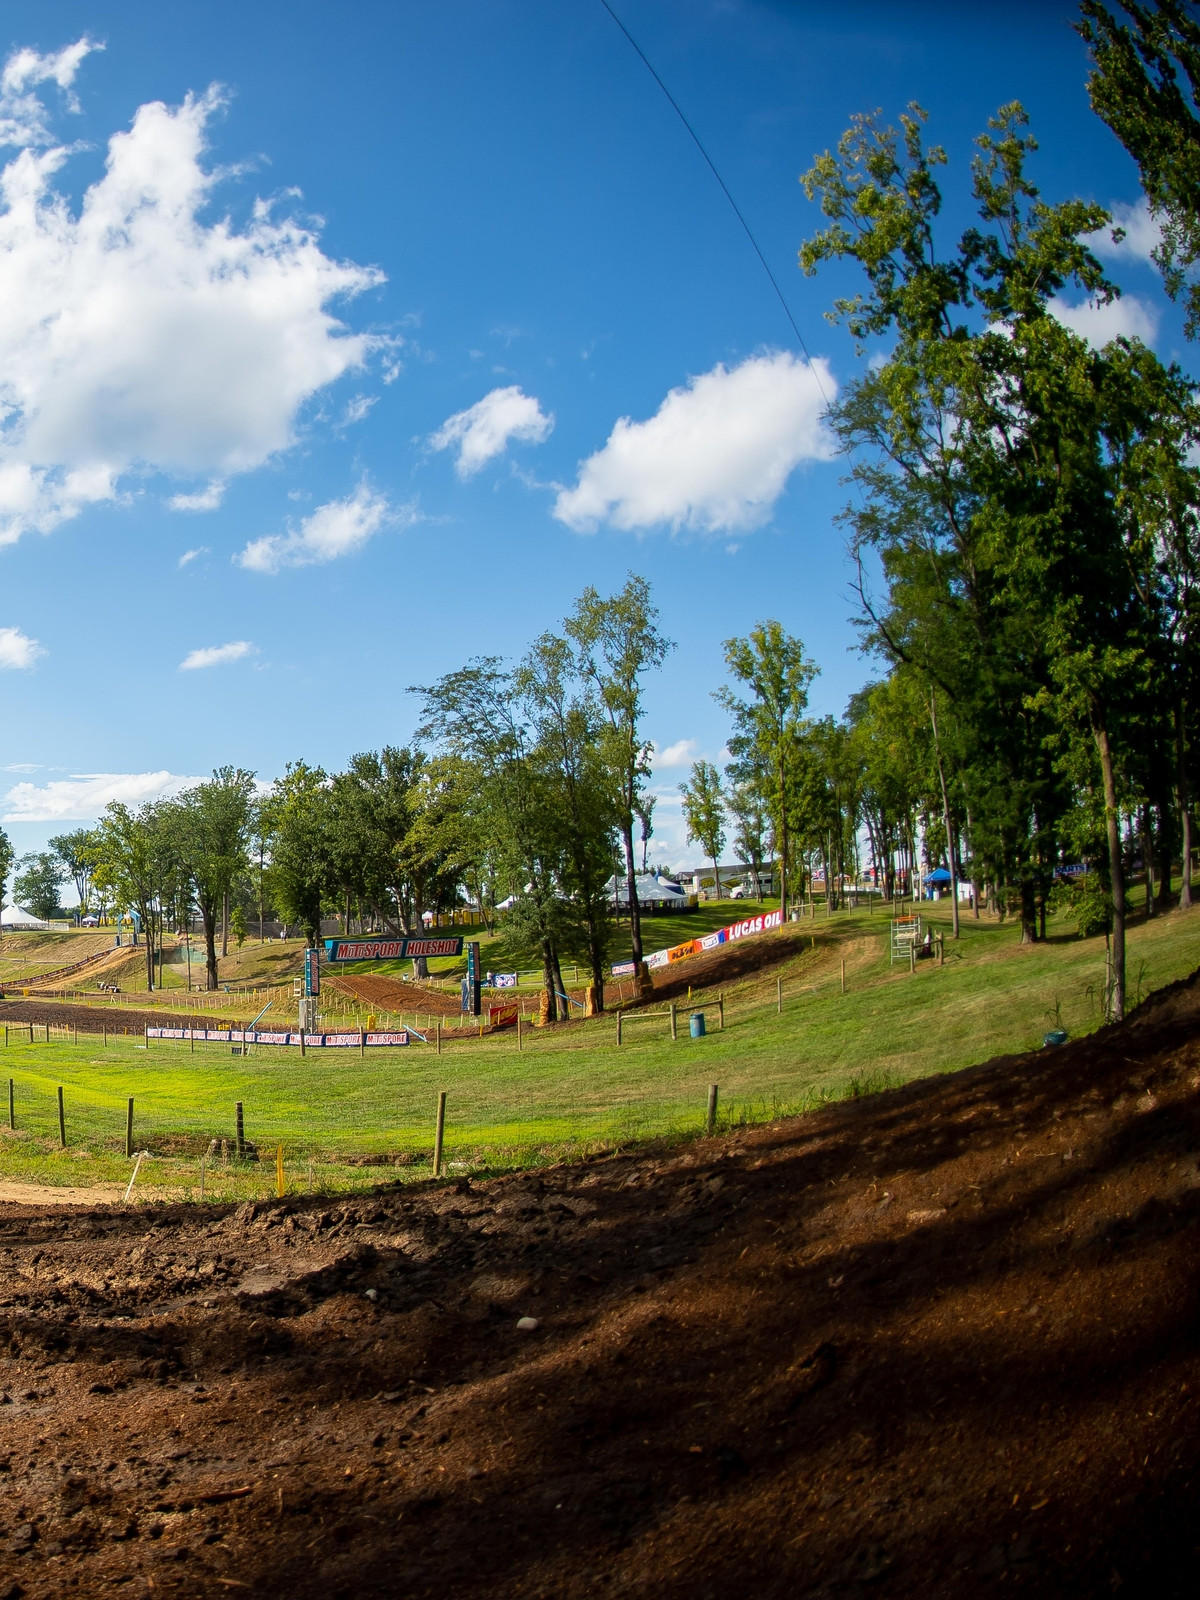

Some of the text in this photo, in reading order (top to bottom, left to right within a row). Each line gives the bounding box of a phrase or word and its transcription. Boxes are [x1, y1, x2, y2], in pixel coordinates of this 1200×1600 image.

[729, 911, 781, 940] LUCAS OIL
[406, 940, 459, 956] HOLESHOT
[672, 946, 693, 960] KTM
